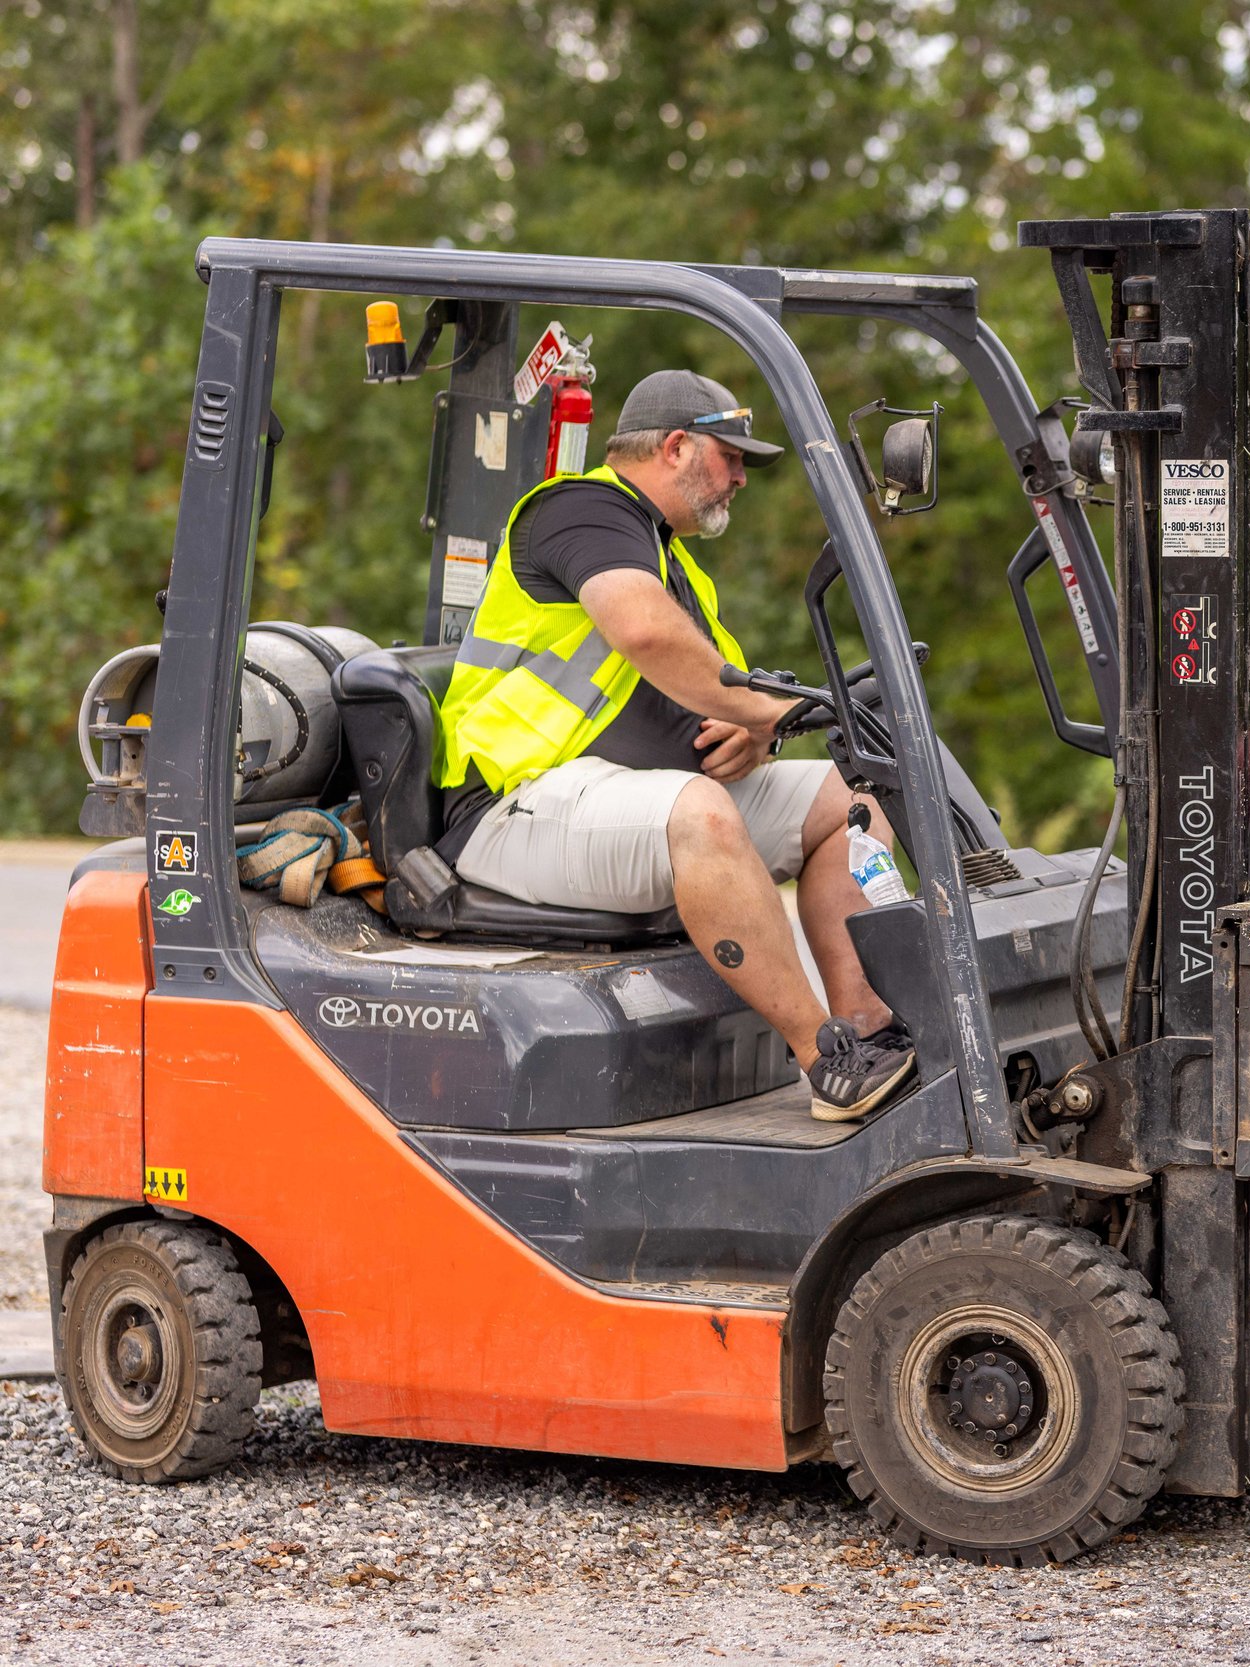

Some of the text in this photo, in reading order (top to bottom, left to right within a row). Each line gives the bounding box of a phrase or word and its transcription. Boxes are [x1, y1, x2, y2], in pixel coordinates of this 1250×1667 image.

[1165, 464, 1225, 478] VESCO
[1163, 488, 1226, 496] SERVICE RENTALS
[1163, 497, 1226, 505] SALES LEASING
[1163, 521, 1225, 532] 1-800-951-3131
[160, 837, 193, 869] SAS
[1179, 765, 1215, 984] TOYOTA
[365, 1002, 480, 1033] TOYOTA
